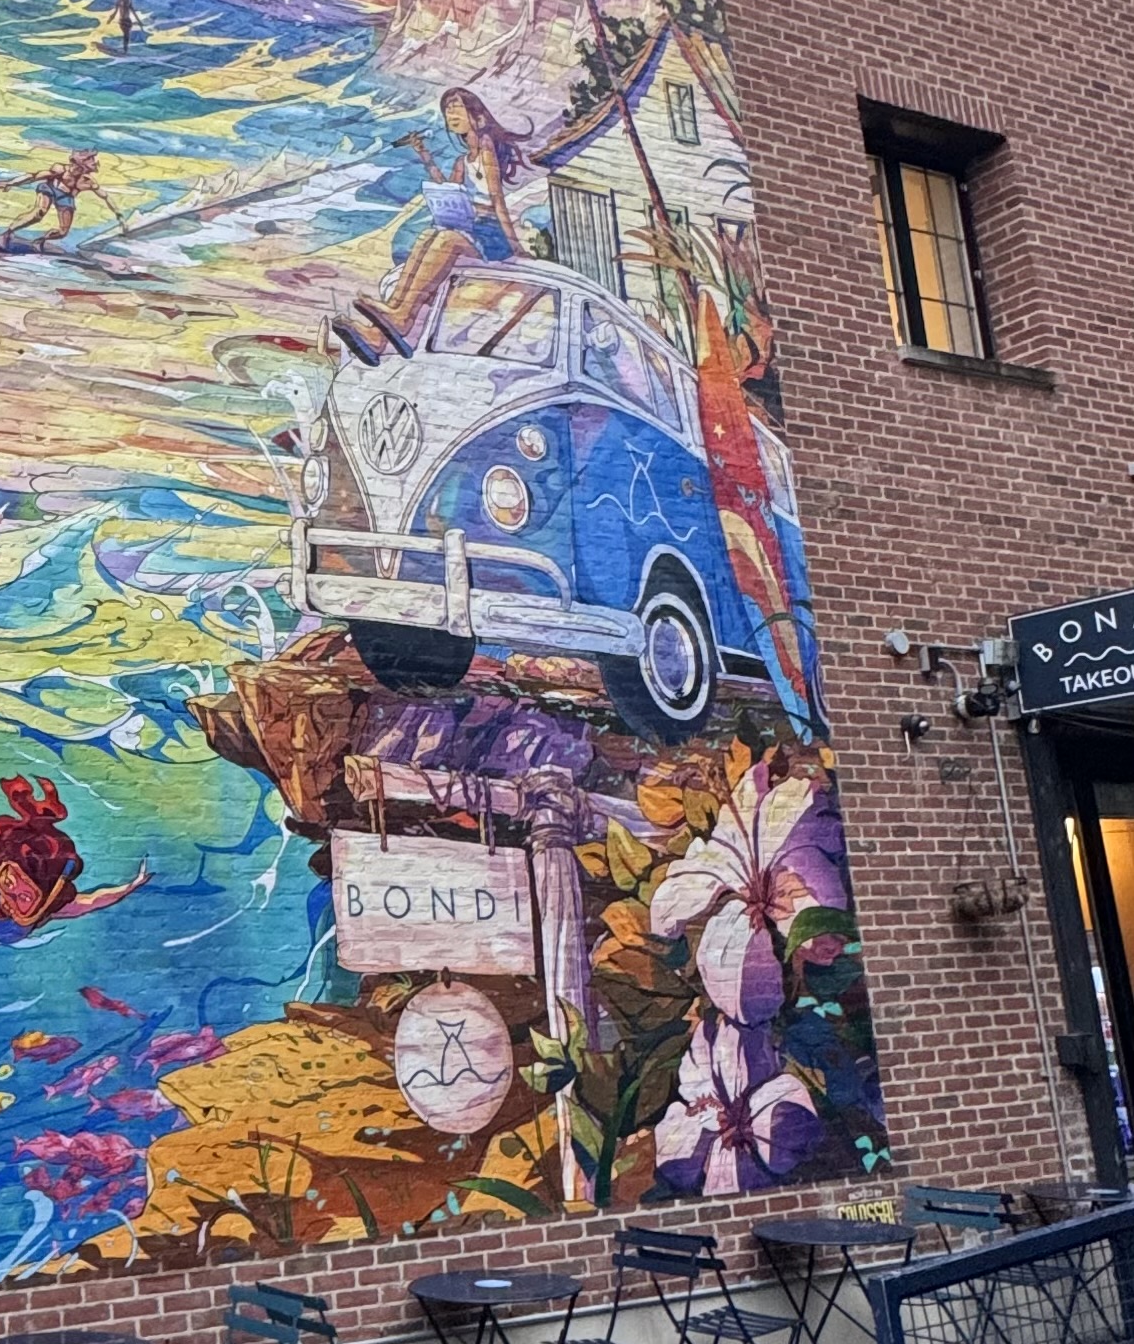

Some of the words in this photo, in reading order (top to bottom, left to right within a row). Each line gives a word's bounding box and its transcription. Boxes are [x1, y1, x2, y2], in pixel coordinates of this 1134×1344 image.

[1031, 607, 1134, 663] BON
[1059, 664, 1134, 694] TAKEO
[347, 884, 520, 922] BONDI
